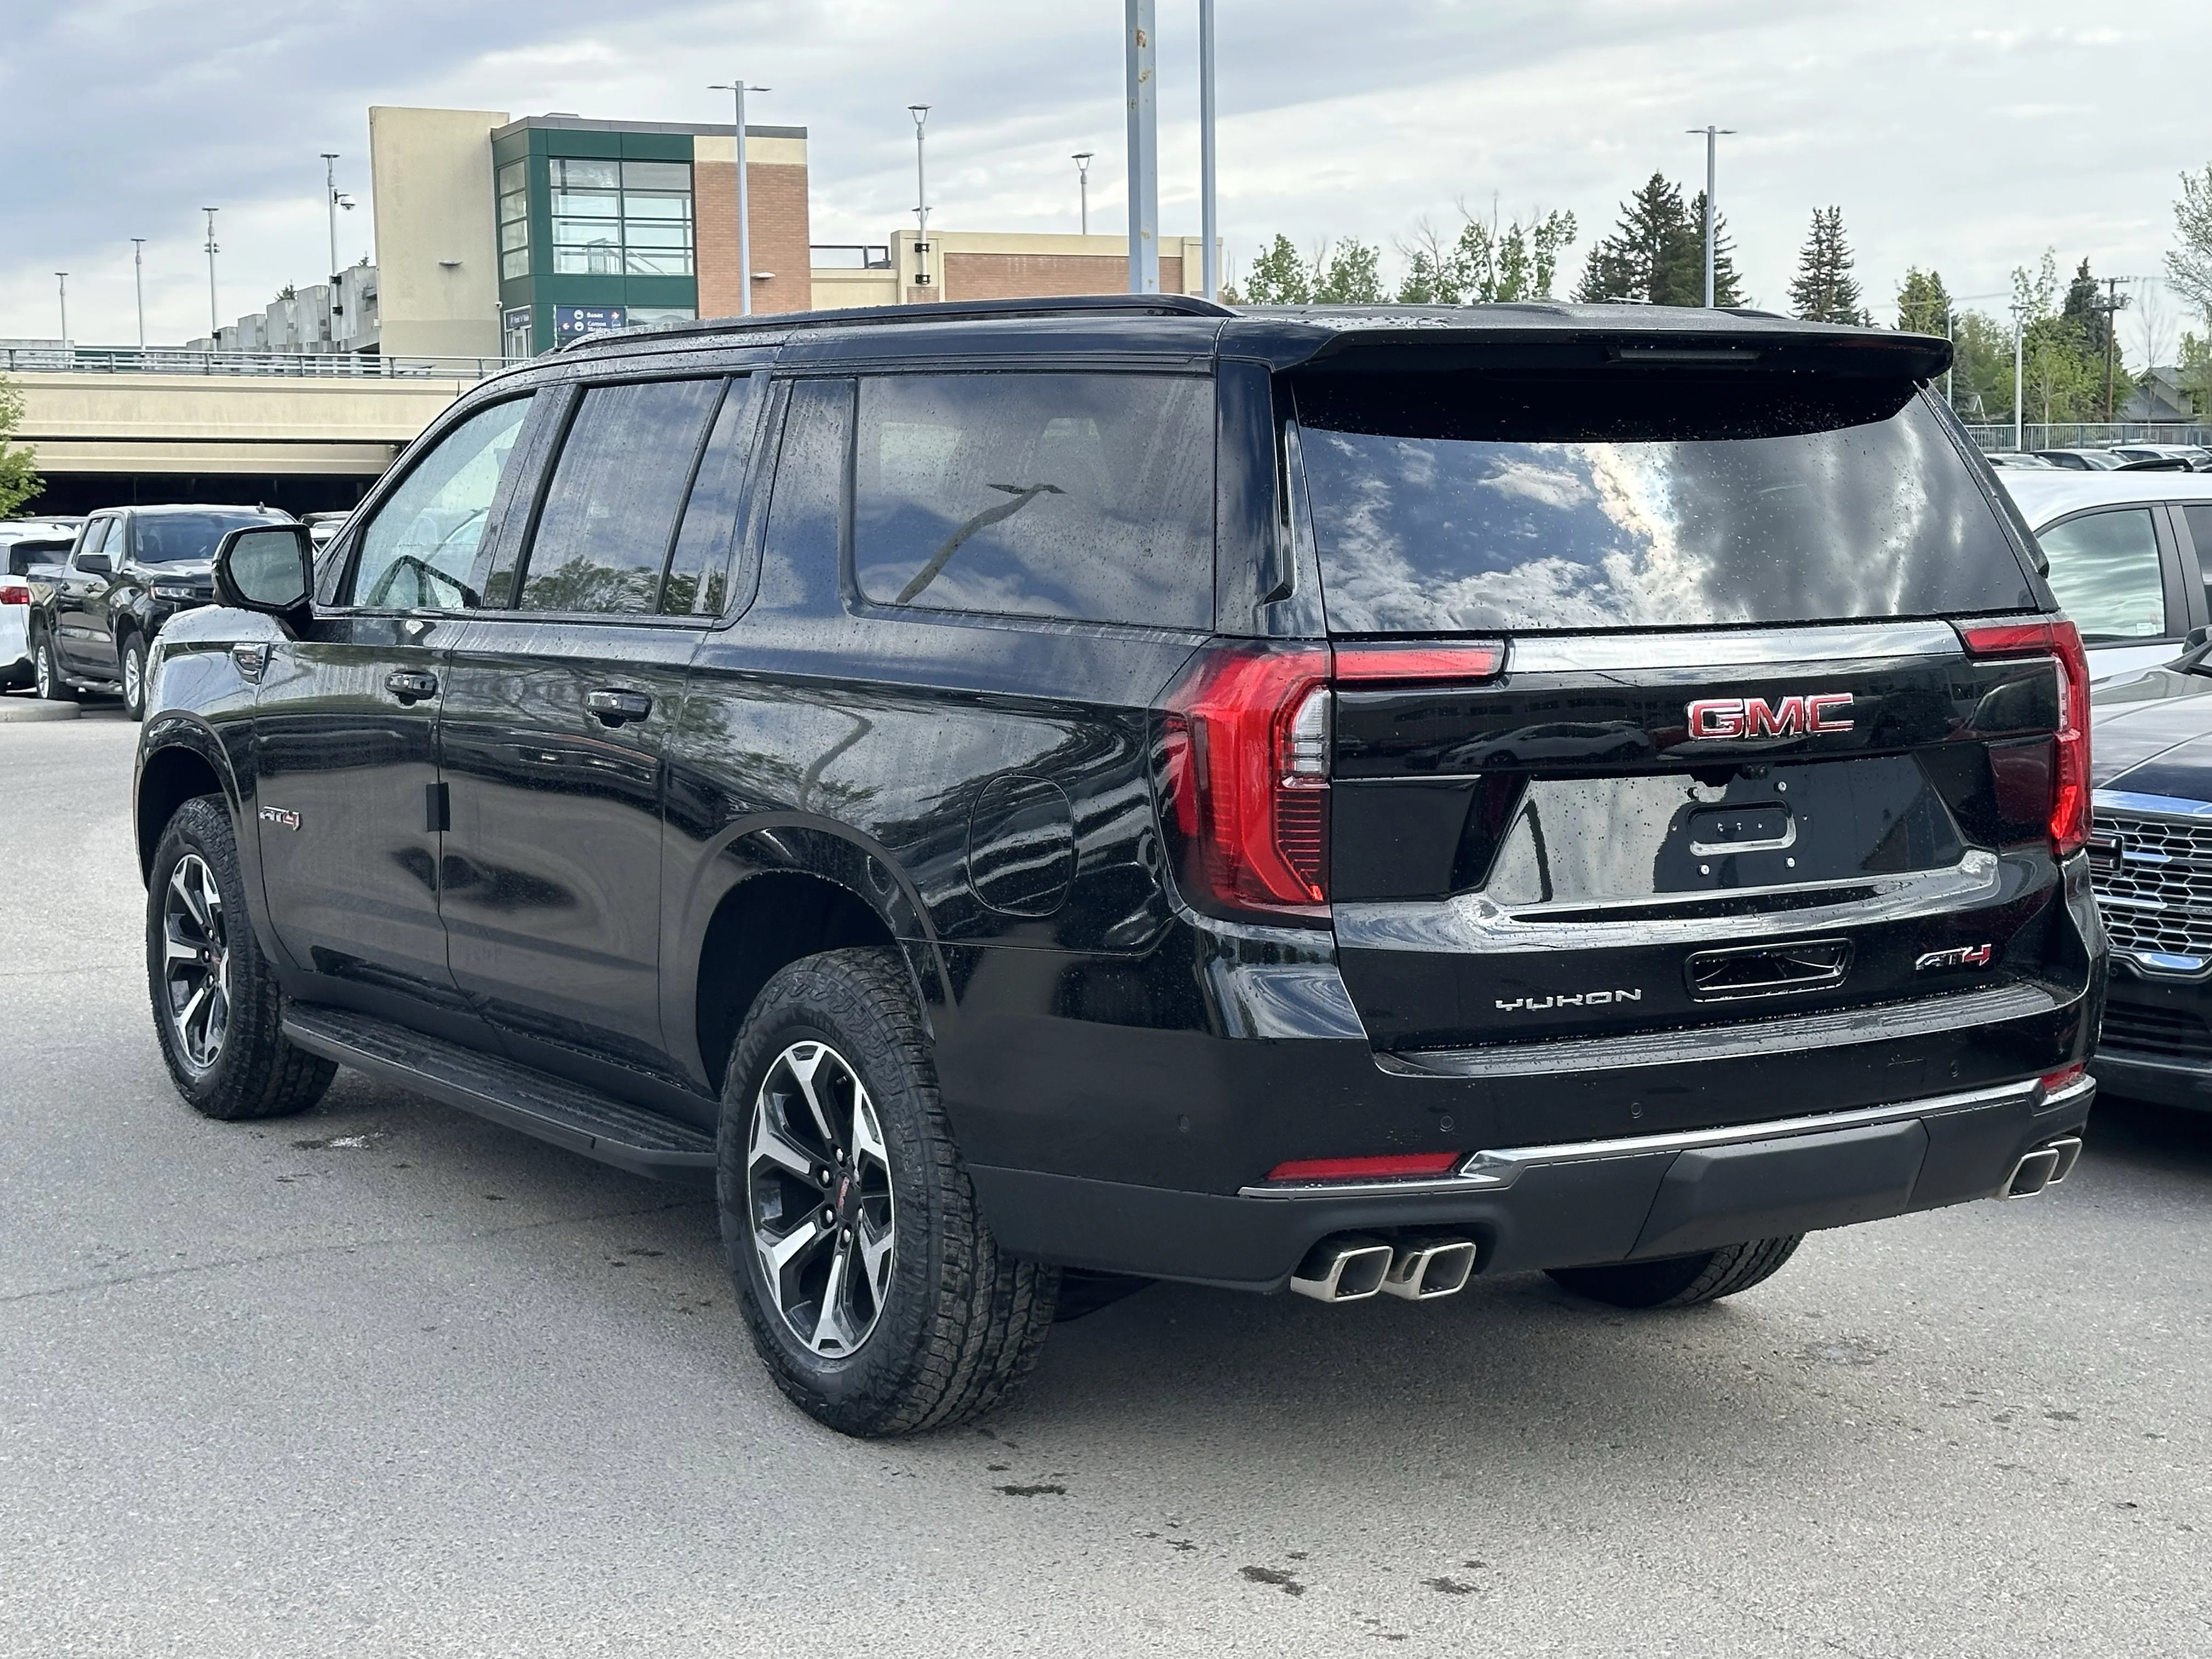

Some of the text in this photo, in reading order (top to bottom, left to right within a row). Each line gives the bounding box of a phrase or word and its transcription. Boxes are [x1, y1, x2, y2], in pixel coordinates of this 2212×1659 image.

[1688, 692, 1854, 740] GMC
[259, 806, 300, 830] AT4
[1915, 943, 1992, 970] AT4
[1495, 988, 1641, 1011] YUKON
